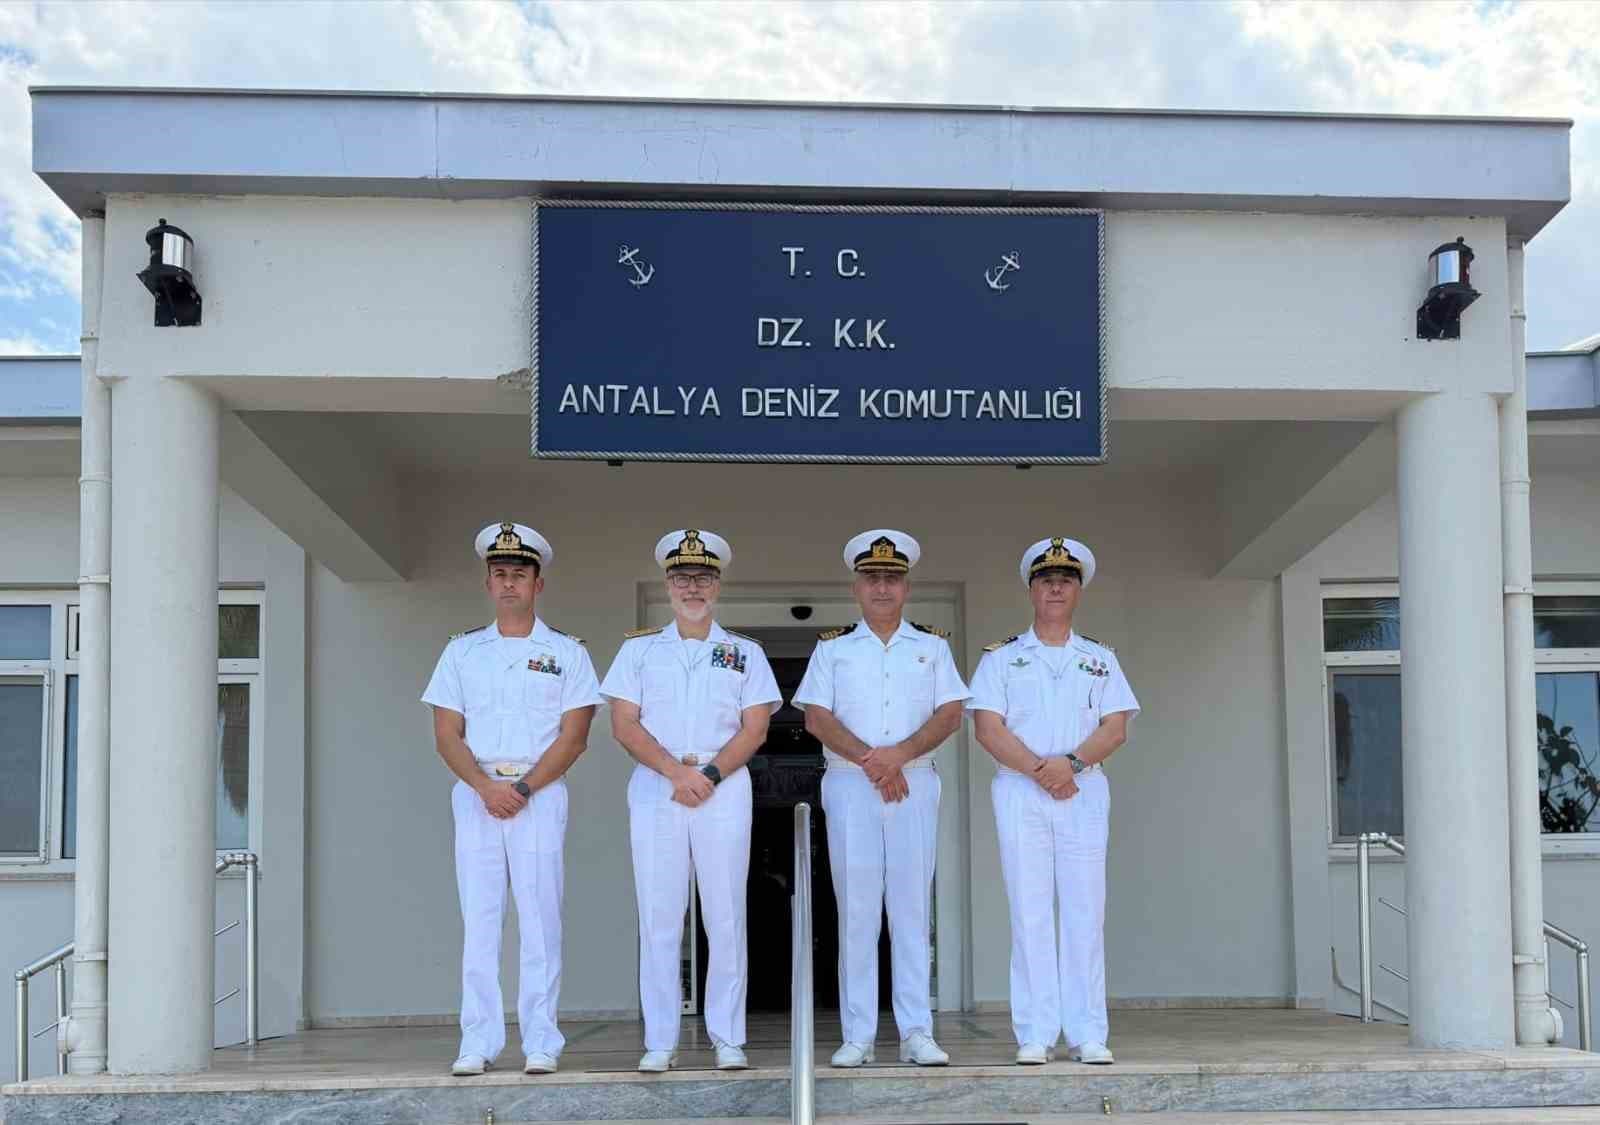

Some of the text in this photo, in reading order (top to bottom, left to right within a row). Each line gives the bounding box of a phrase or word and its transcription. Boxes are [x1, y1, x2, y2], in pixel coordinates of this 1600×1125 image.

[782, 246, 867, 277] T. C.
[757, 316, 896, 349] DZ. K.K.
[559, 383, 1081, 420] ANTALYA DENİZ KOMUTANLIĞI
